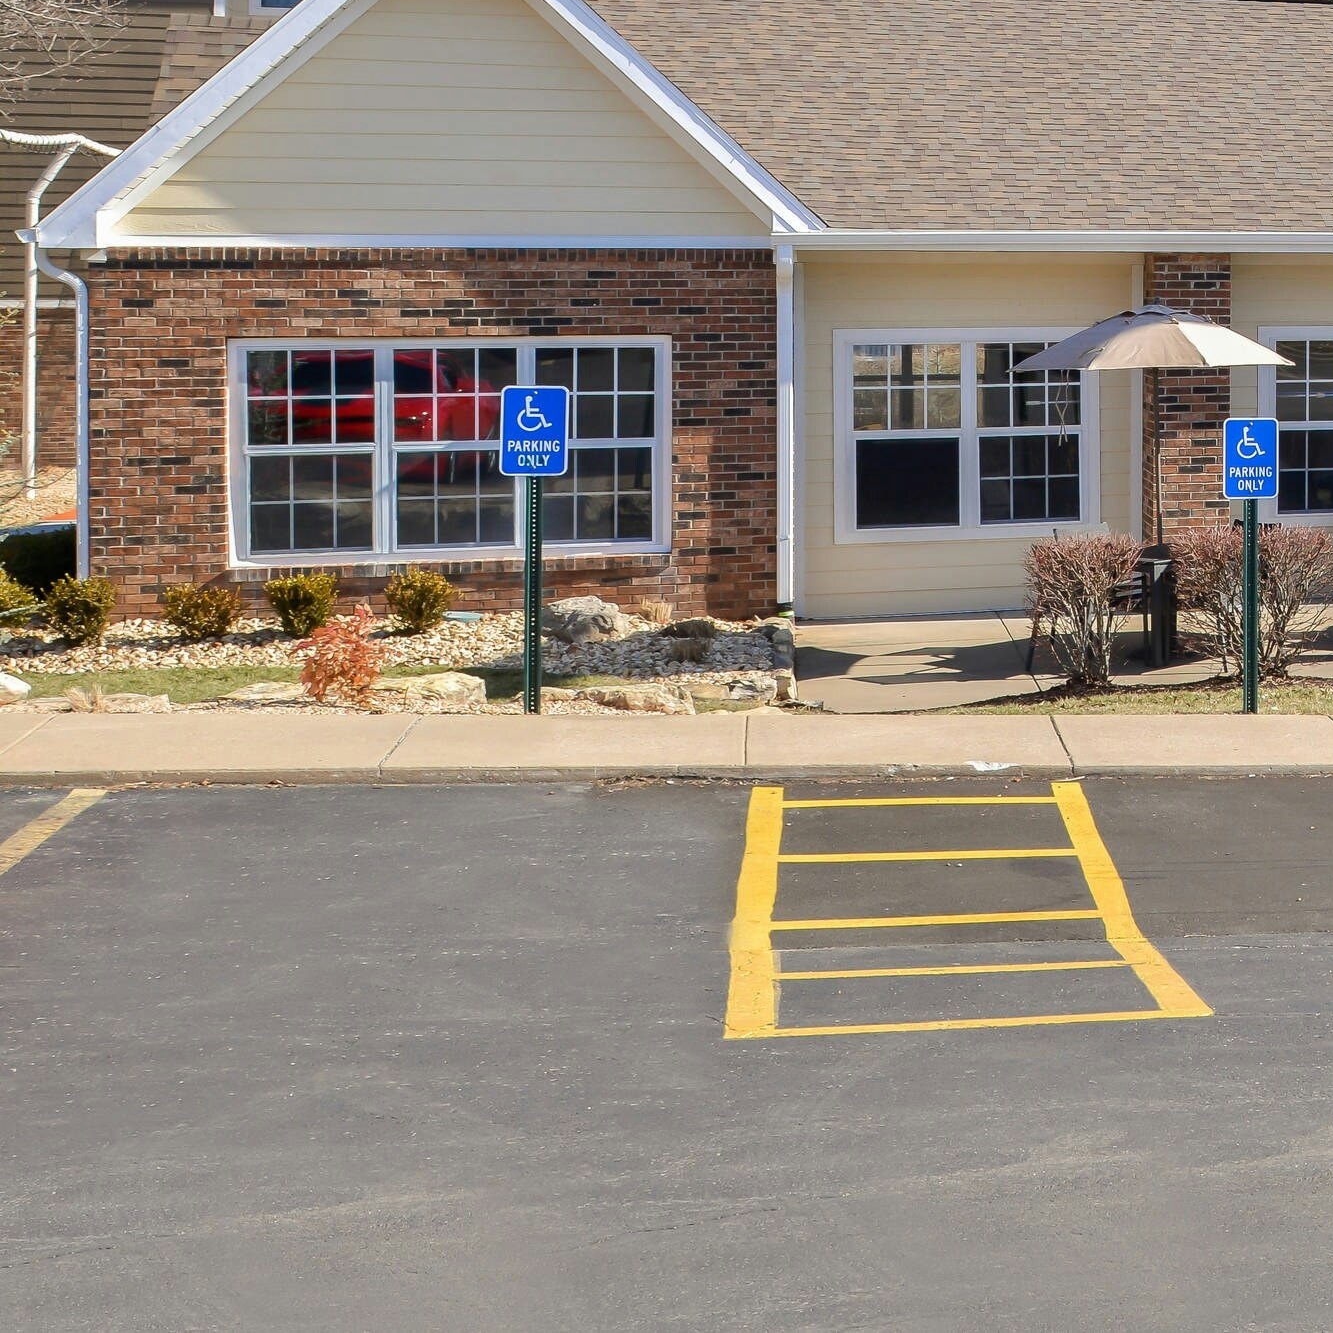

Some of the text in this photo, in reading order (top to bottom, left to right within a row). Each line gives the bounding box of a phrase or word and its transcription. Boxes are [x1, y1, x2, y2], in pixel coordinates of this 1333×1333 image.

[507, 440, 560, 452] PARKING
[517, 454, 550, 467] ONLY
[1229, 466, 1273, 477] PARKING
[1237, 479, 1264, 492] ONLY
